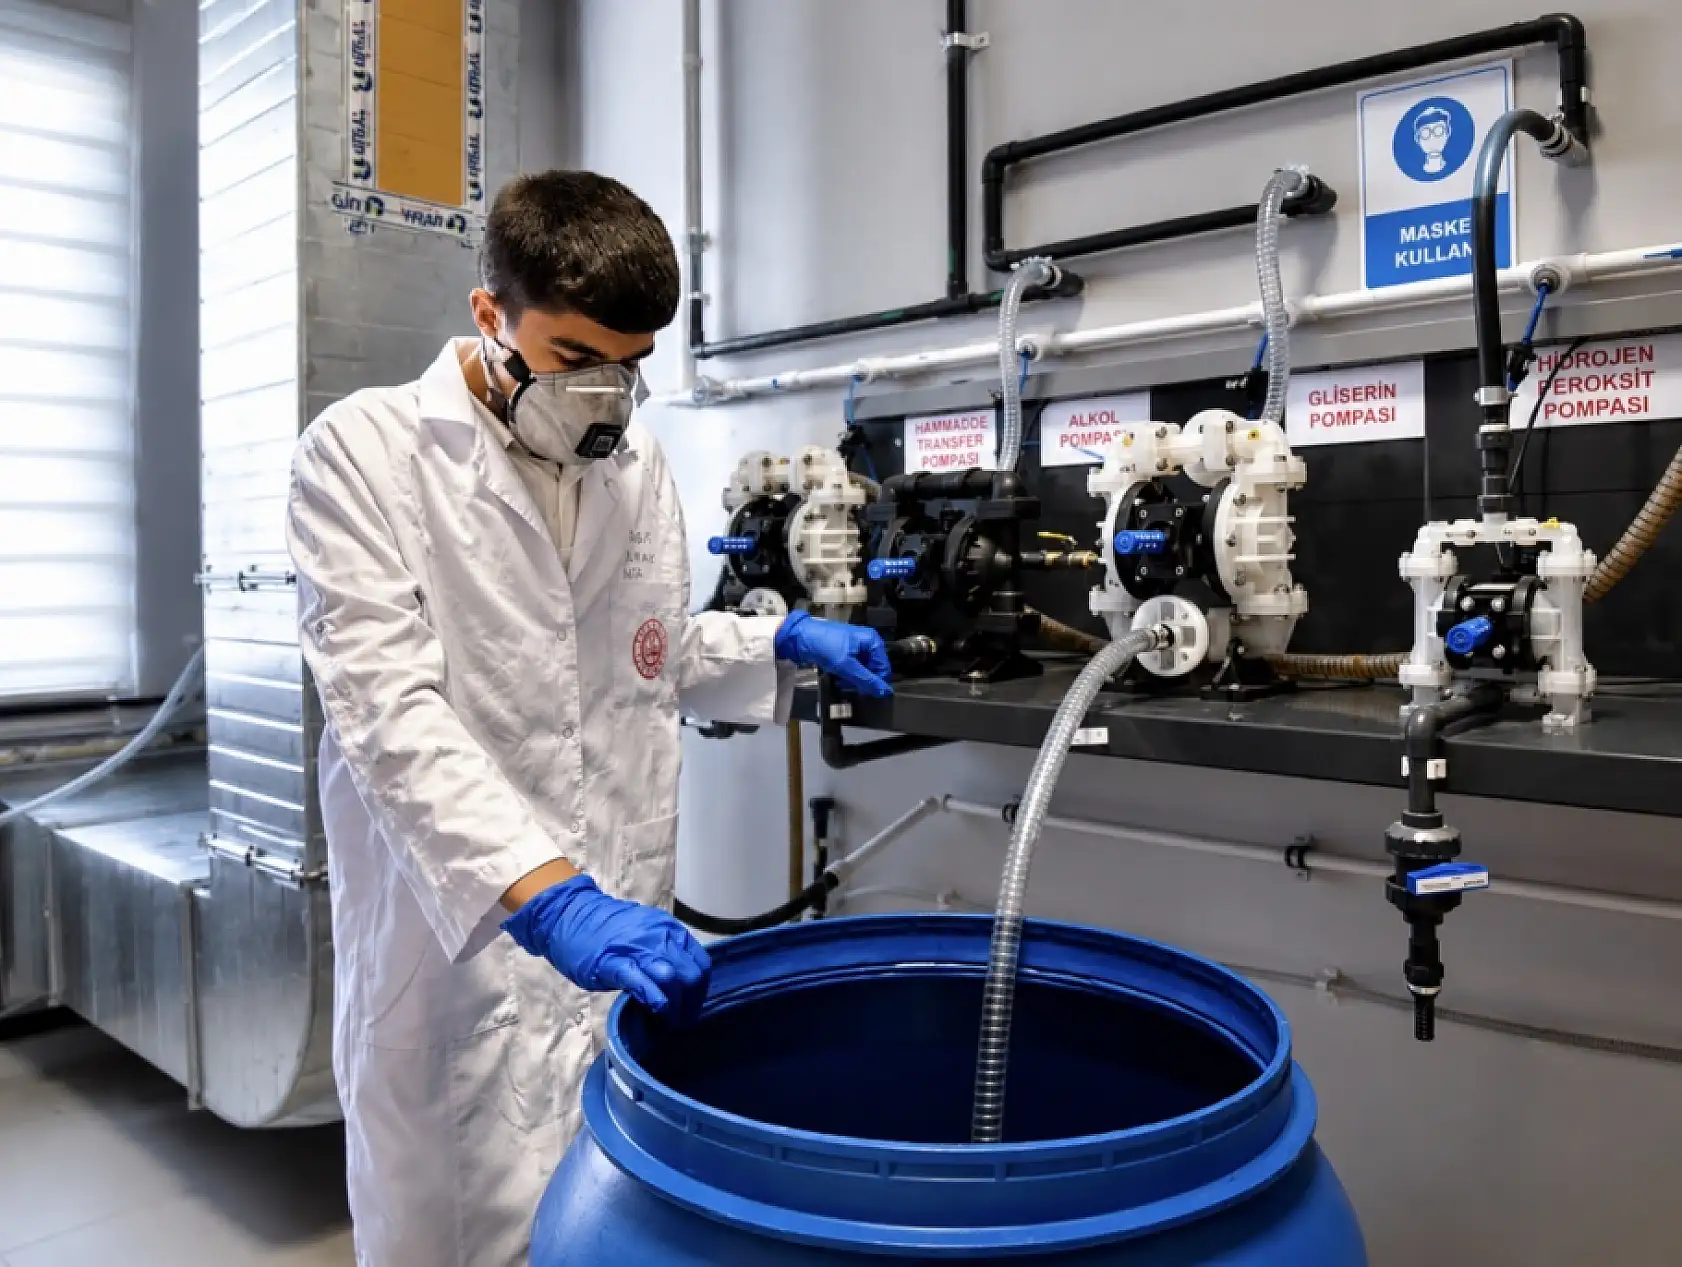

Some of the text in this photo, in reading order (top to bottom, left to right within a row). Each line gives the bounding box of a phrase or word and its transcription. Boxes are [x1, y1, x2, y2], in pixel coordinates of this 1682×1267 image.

[1400, 217, 1472, 244] MASKE
[1538, 344, 1654, 373] HİDROJEN
[1309, 380, 1396, 406] GLİSERİN
[1537, 367, 1656, 398] PEROKSİT
[1069, 409, 1119, 428] ALKOL
[1310, 406, 1396, 428] POMPASI
[1544, 395, 1649, 420] POMPASI
[915, 415, 988, 434] HAMMADDE
[917, 434, 984, 452] TRANSFER
[1060, 429, 1126, 448] POMPA
[922, 452, 979, 469] POMPASI
